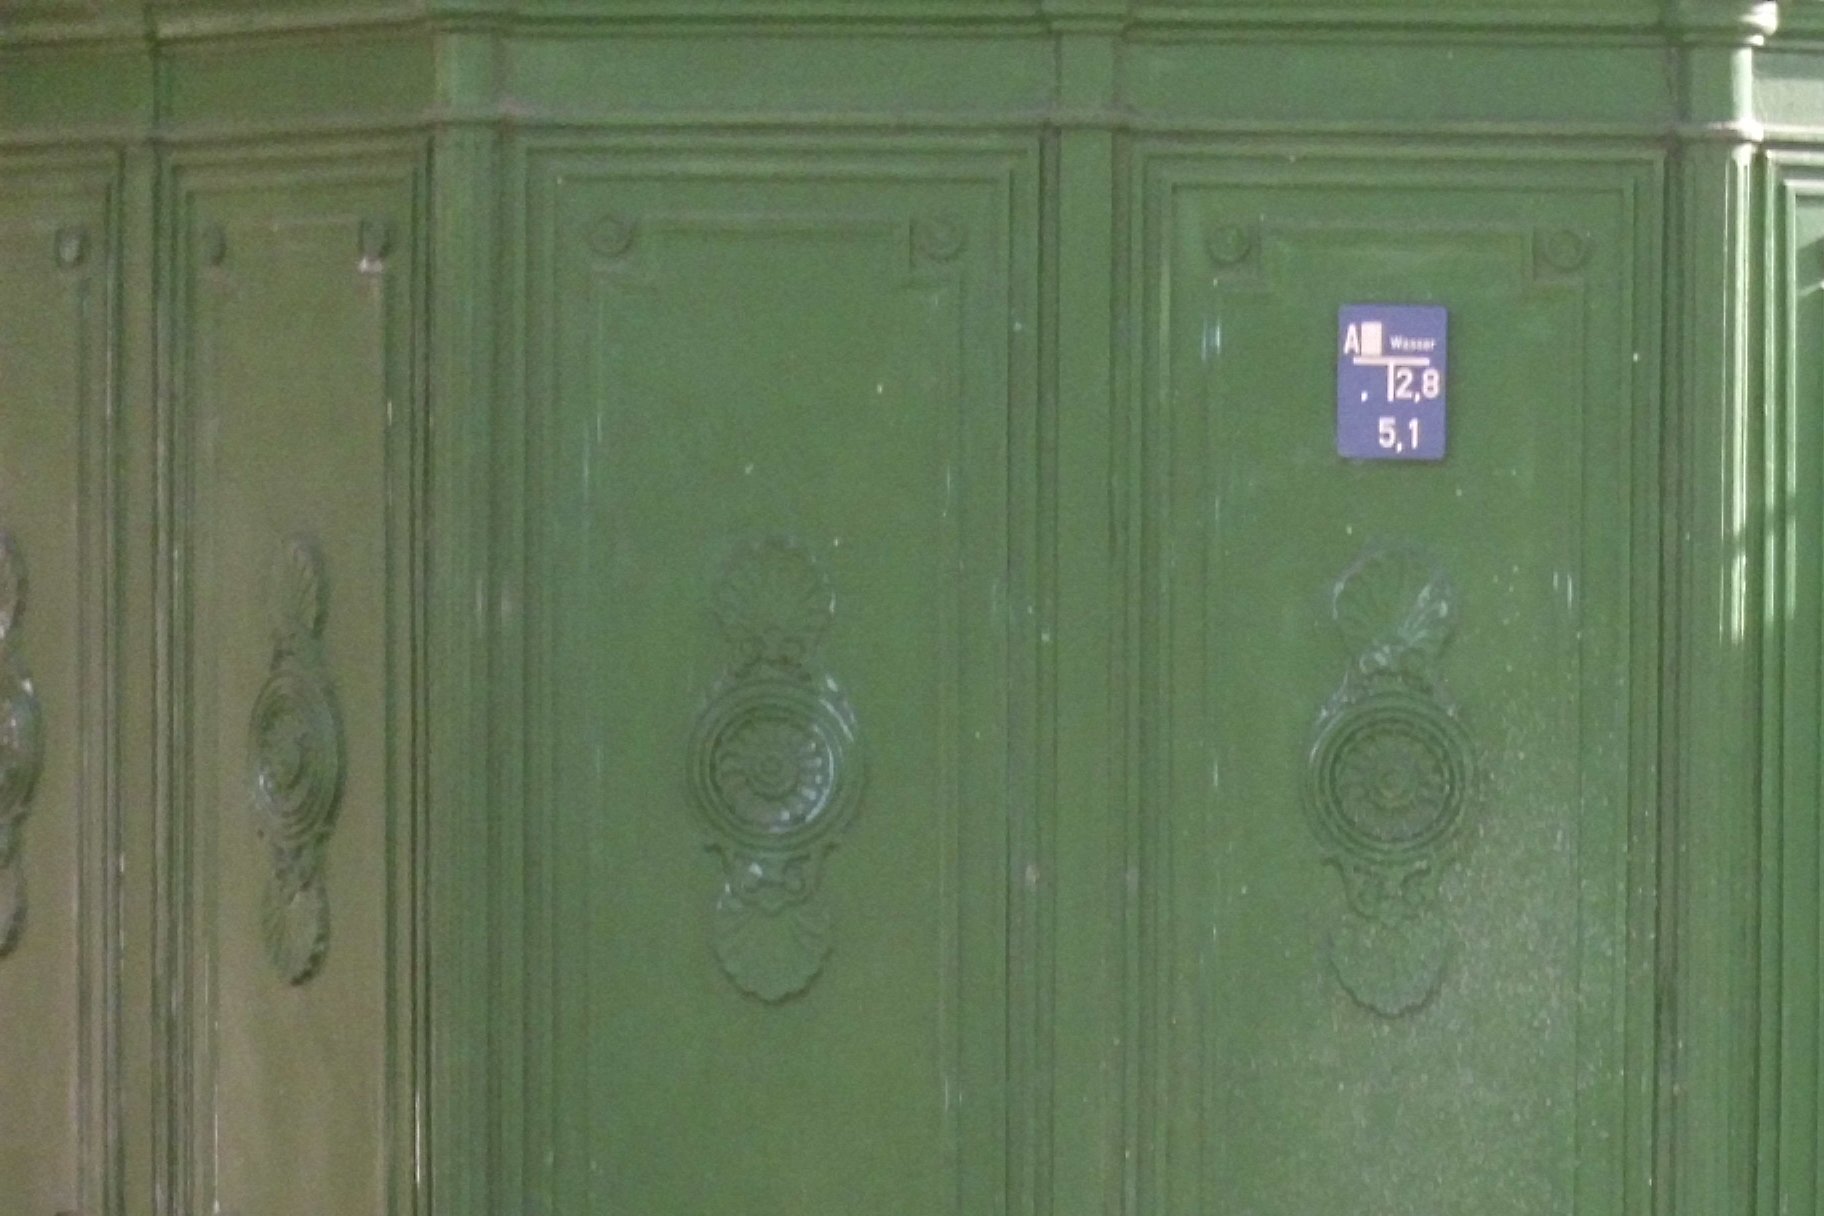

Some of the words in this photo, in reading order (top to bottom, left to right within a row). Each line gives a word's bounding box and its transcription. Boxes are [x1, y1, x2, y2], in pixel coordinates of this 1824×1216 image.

[1343, 323, 1361, 354] A
[1396, 368, 1440, 404] 2,8
[1379, 417, 1419, 454] 5,1
